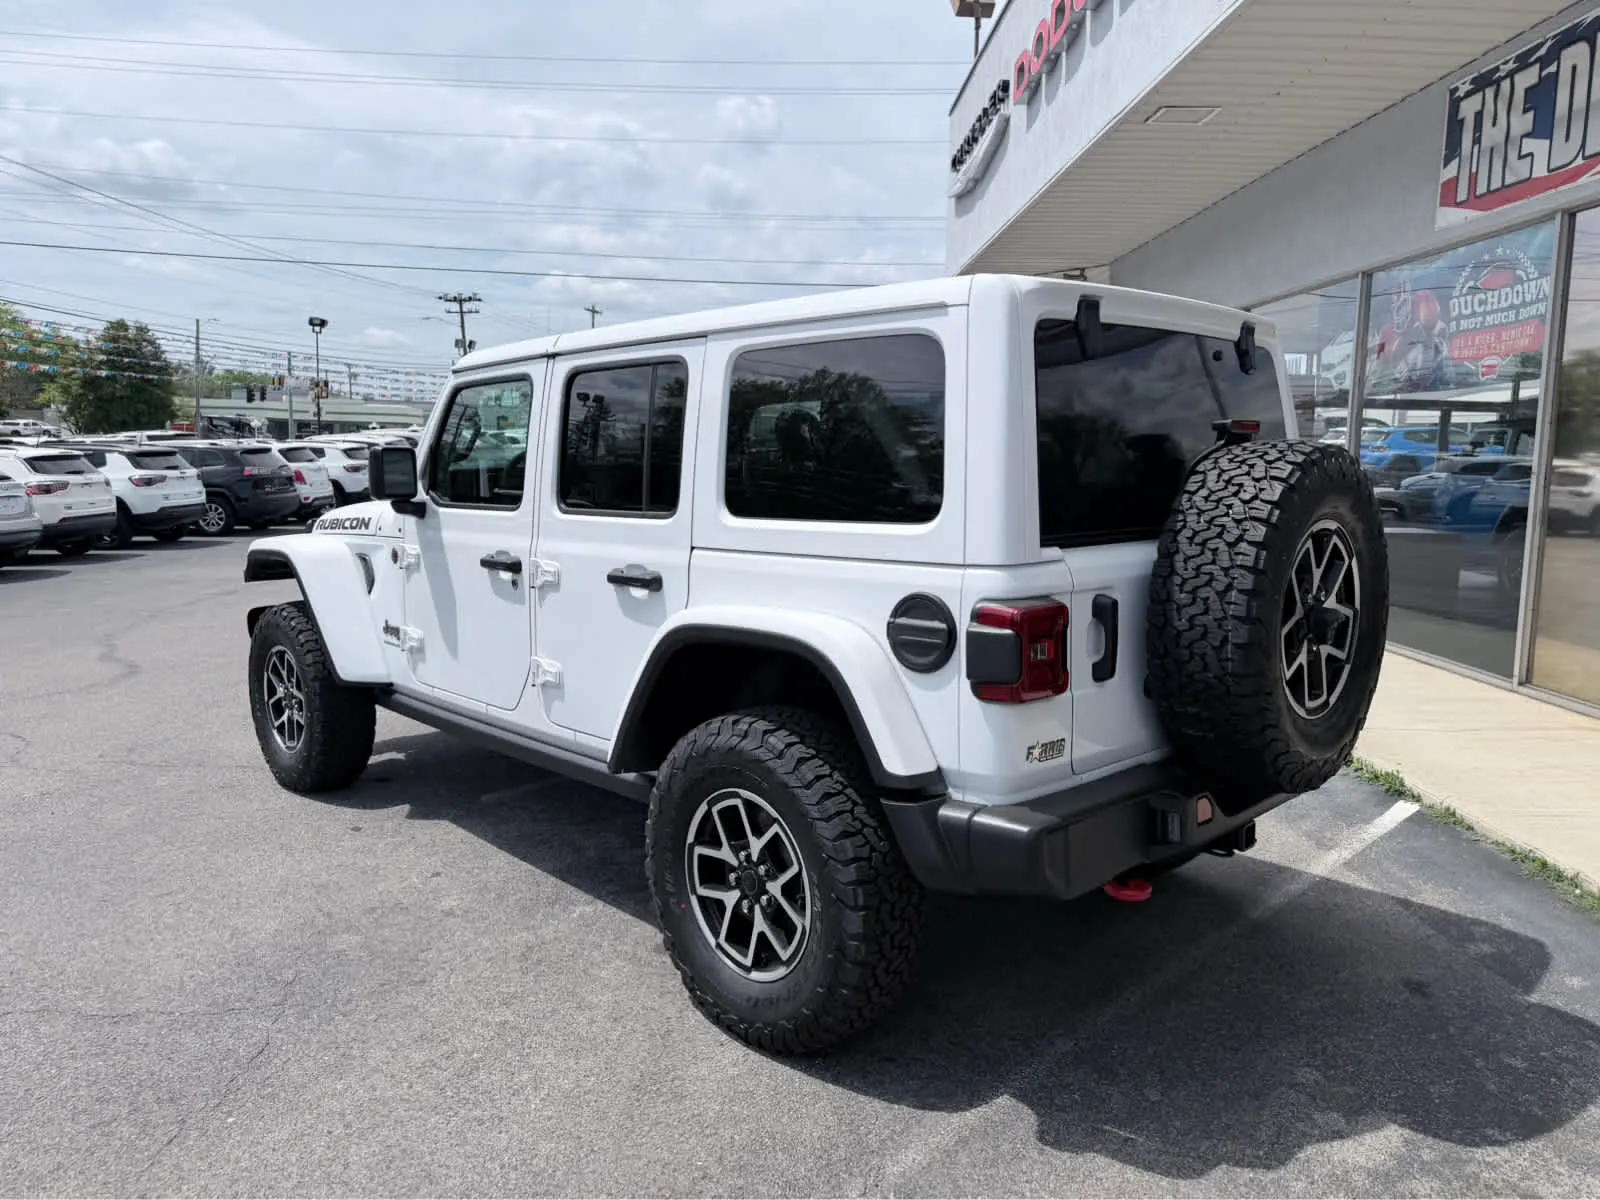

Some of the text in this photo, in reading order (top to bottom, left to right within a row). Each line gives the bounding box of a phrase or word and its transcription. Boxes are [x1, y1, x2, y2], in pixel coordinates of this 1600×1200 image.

[1013, 0, 1086, 105] DOD
[1456, 62, 1541, 205] THE
[1449, 276, 1551, 317] OUCHDOWN
[1459, 317, 1484, 332] NOT
[1485, 311, 1516, 326] MUCH
[1519, 303, 1547, 318] DOWN
[315, 517, 372, 530] RUBICON
